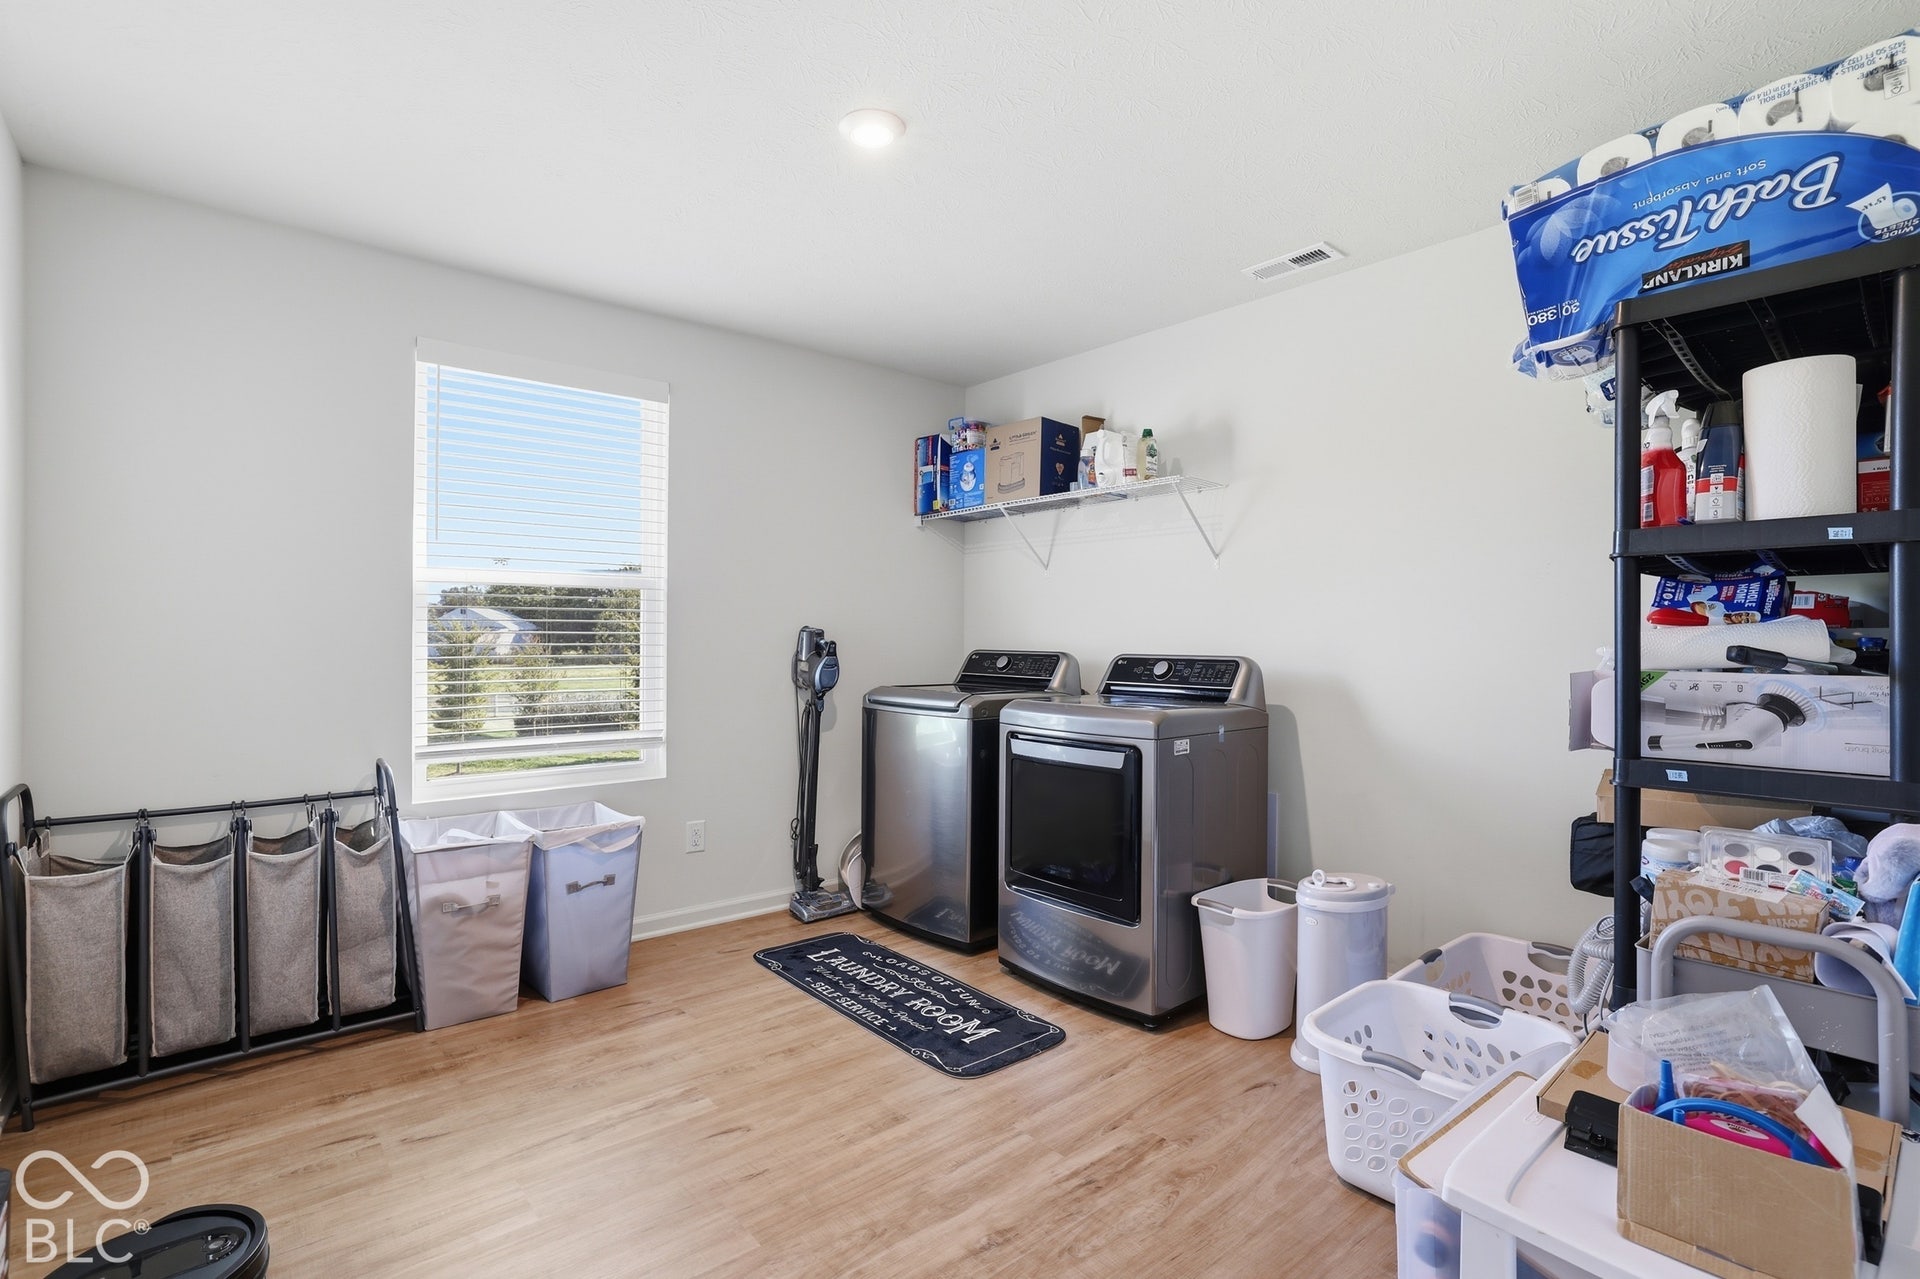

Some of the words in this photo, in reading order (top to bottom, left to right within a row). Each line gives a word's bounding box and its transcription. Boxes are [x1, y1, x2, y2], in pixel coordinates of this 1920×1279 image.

[1841, 62, 1865, 75] ROLLS
[1706, 171, 1732, 185] and
[1737, 160, 1767, 176] Soft
[1632, 180, 1700, 210] Absorbent
[1696, 156, 1840, 230] Bath
[1571, 200, 1698, 263] Tissue
[1875, 218, 1920, 235] SHEETS
[1882, 226, 1914, 239] WIDE
[1528, 309, 1557, 326] 380
[1562, 302, 1580, 316] 30
[1734, 584, 1749, 604] HOME
[1745, 582, 1760, 608] WHOLE
[876, 956, 930, 976] LOADS
[931, 976, 953, 986] OF
[951, 988, 980, 1009] FUN
[807, 948, 916, 998] LAUNDRY
[904, 997, 1001, 1044] ROOM
[836, 996, 889, 1026] SERVICE
